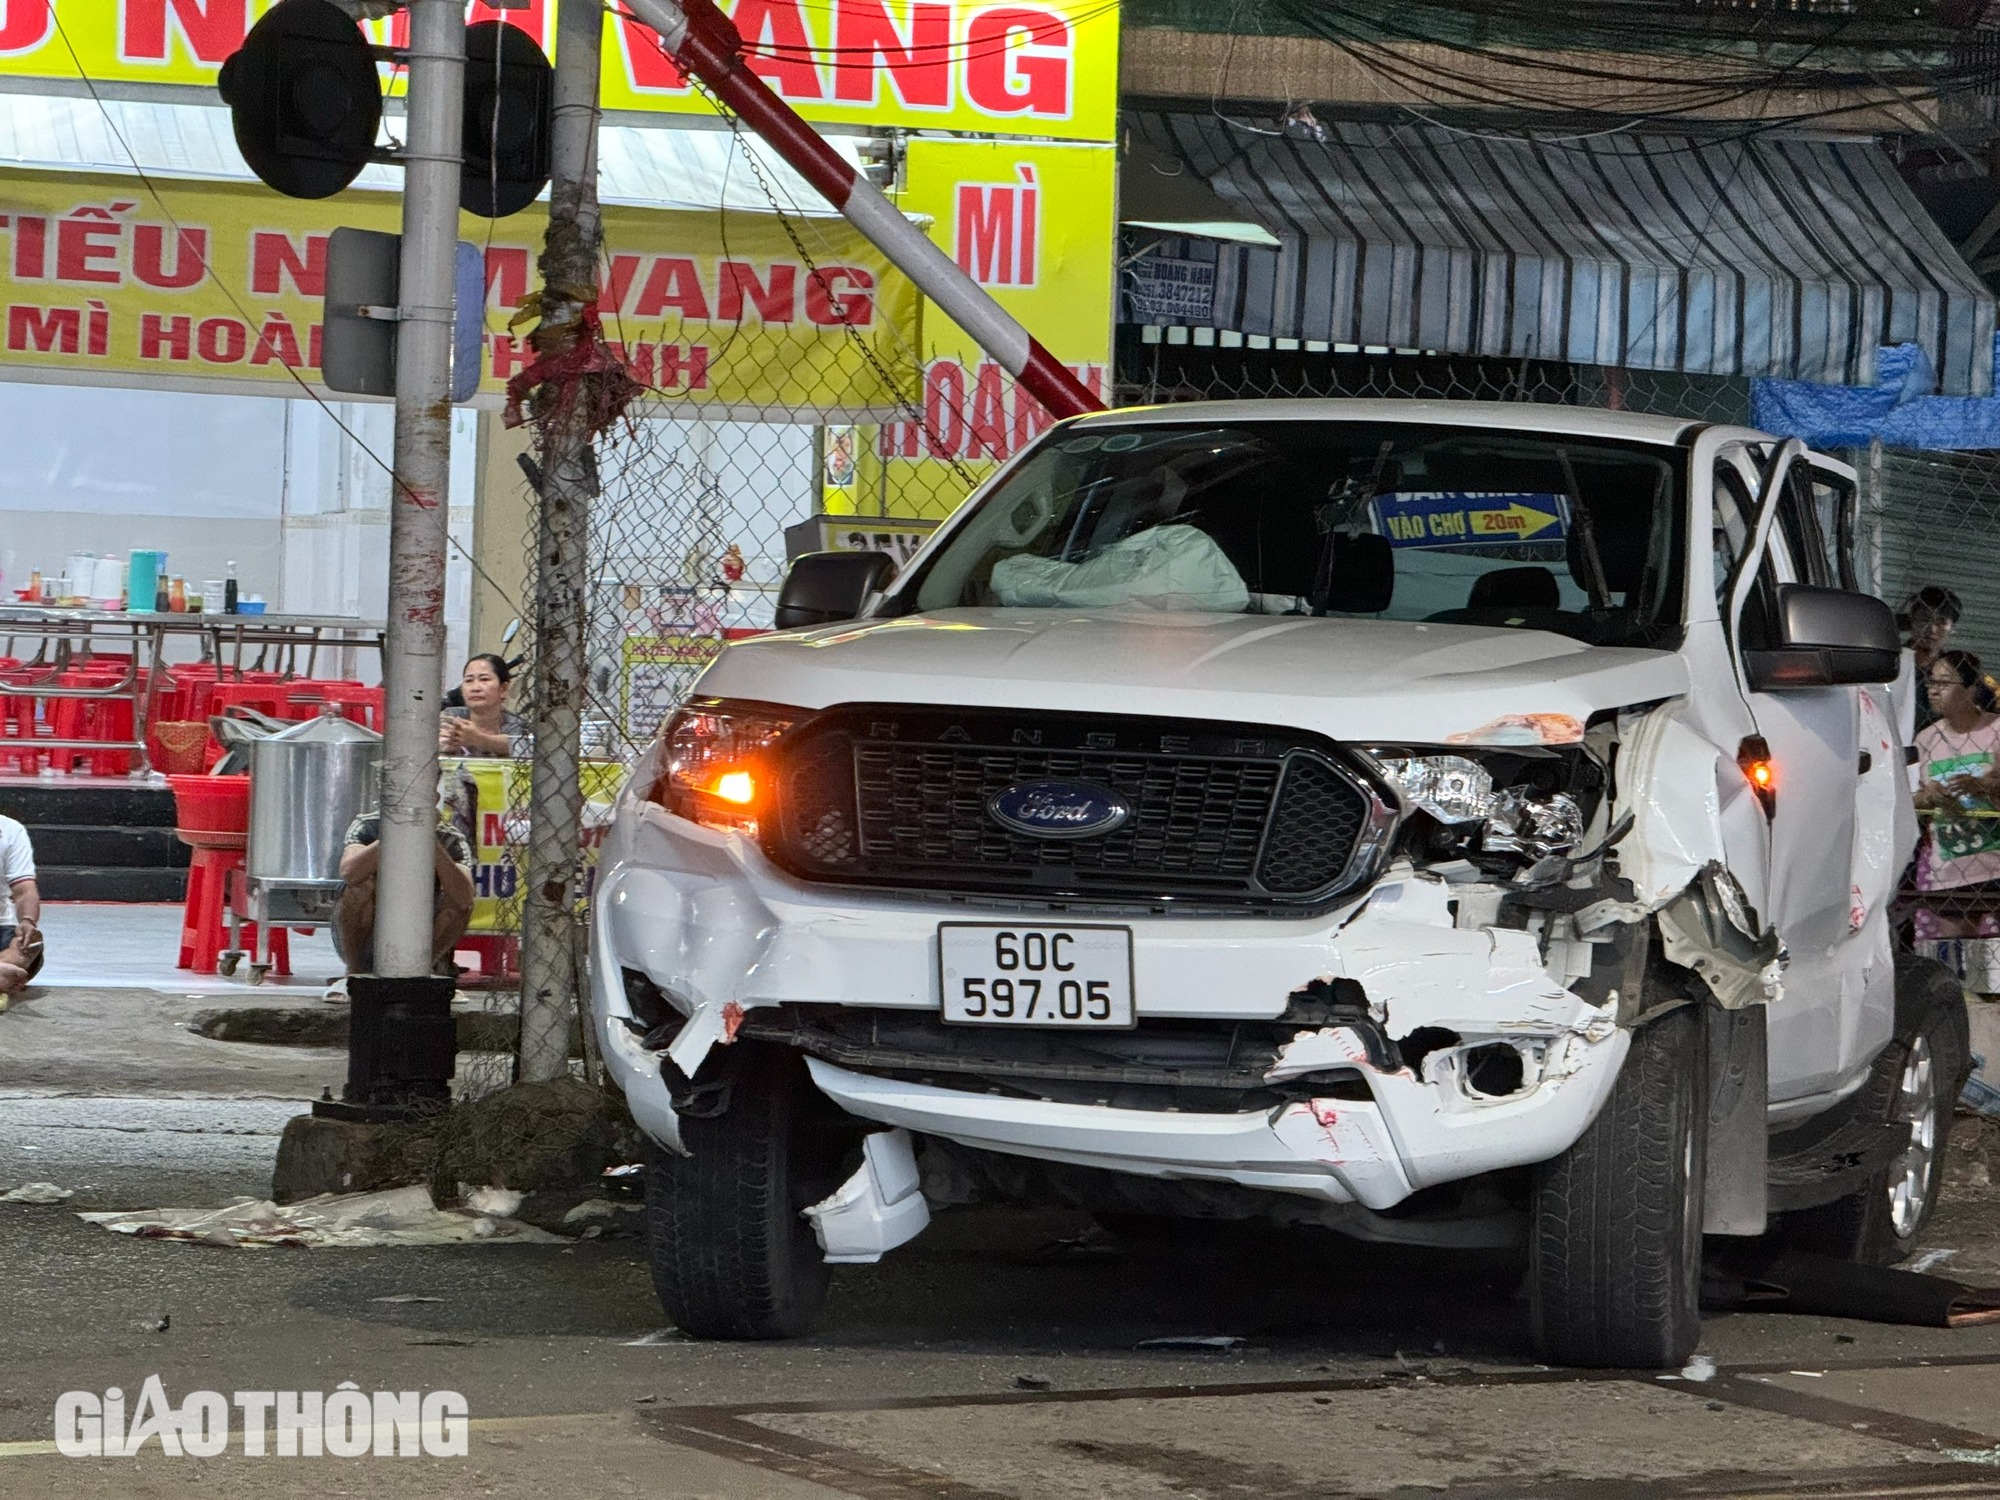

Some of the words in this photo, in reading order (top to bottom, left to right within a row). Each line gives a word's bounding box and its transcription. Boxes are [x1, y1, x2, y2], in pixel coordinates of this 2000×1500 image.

[0, 202, 206, 288] IẾU
[958, 166, 1037, 285] MÌ
[8, 301, 109, 355] MÌ
[1387, 511, 1425, 540] VÀO
[1428, 510, 1466, 540] CHỢ
[1483, 514, 1527, 531] 20m
[870, 721, 1266, 755] RANGER
[1017, 790, 1090, 823] Ford
[995, 931, 1075, 971] 60C
[962, 978, 1111, 1020] 597.05
